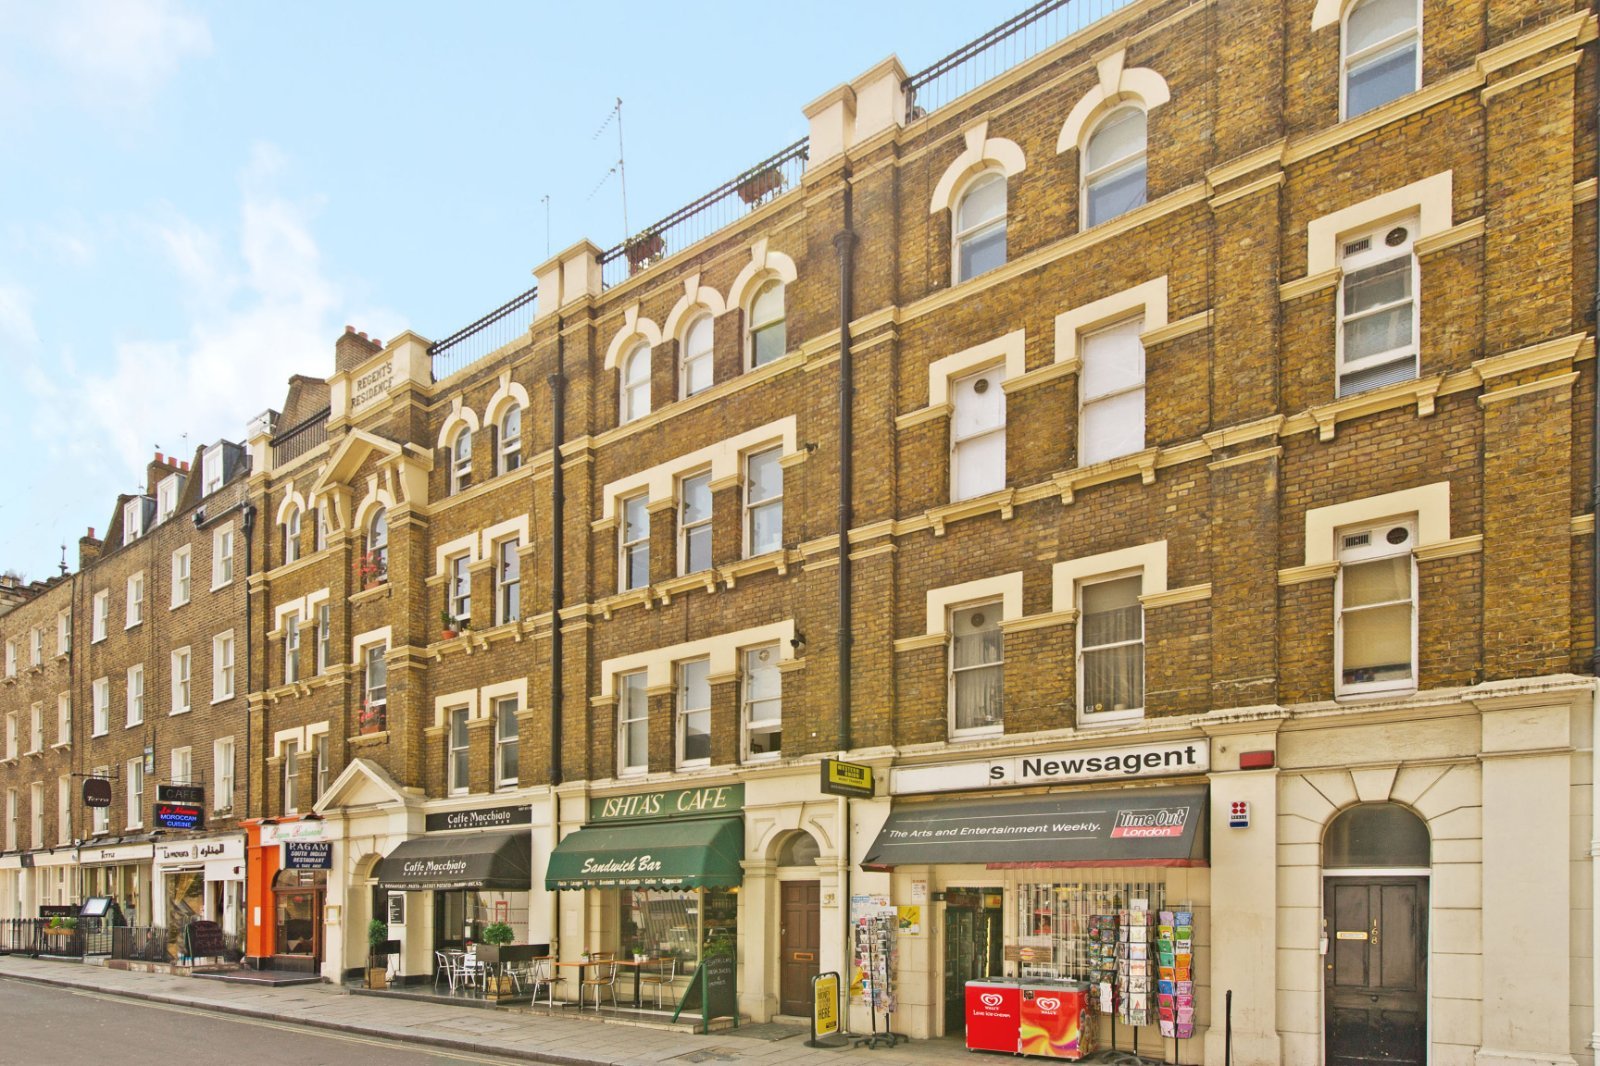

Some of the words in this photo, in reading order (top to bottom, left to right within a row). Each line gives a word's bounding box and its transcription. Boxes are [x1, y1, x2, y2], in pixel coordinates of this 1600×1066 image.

[357, 361, 392, 391] REGENT'S
[351, 376, 394, 408] RESIDENCE
[1022, 746, 1196, 777] Newsagent
[166, 789, 197, 800] CAFE
[602, 794, 664, 817] ISHTA'S
[677, 787, 732, 812] CAFE
[469, 810, 511, 822] Macchiato
[1121, 811, 1155, 826] Time
[1156, 807, 1184, 826] Out
[166, 820, 192, 828] CUISINE
[889, 830, 908, 838] The
[909, 829, 933, 837] Arts
[935, 828, 959, 836] and
[960, 824, 1048, 835] Entertainment
[1052, 823, 1101, 833] Weekly.
[1123, 826, 1171, 836] London
[289, 842, 328, 851] RAGAM
[425, 859, 467, 872] Macchiato
[581, 856, 637, 873] Sandwich
[638, 855, 662, 871] Bar
